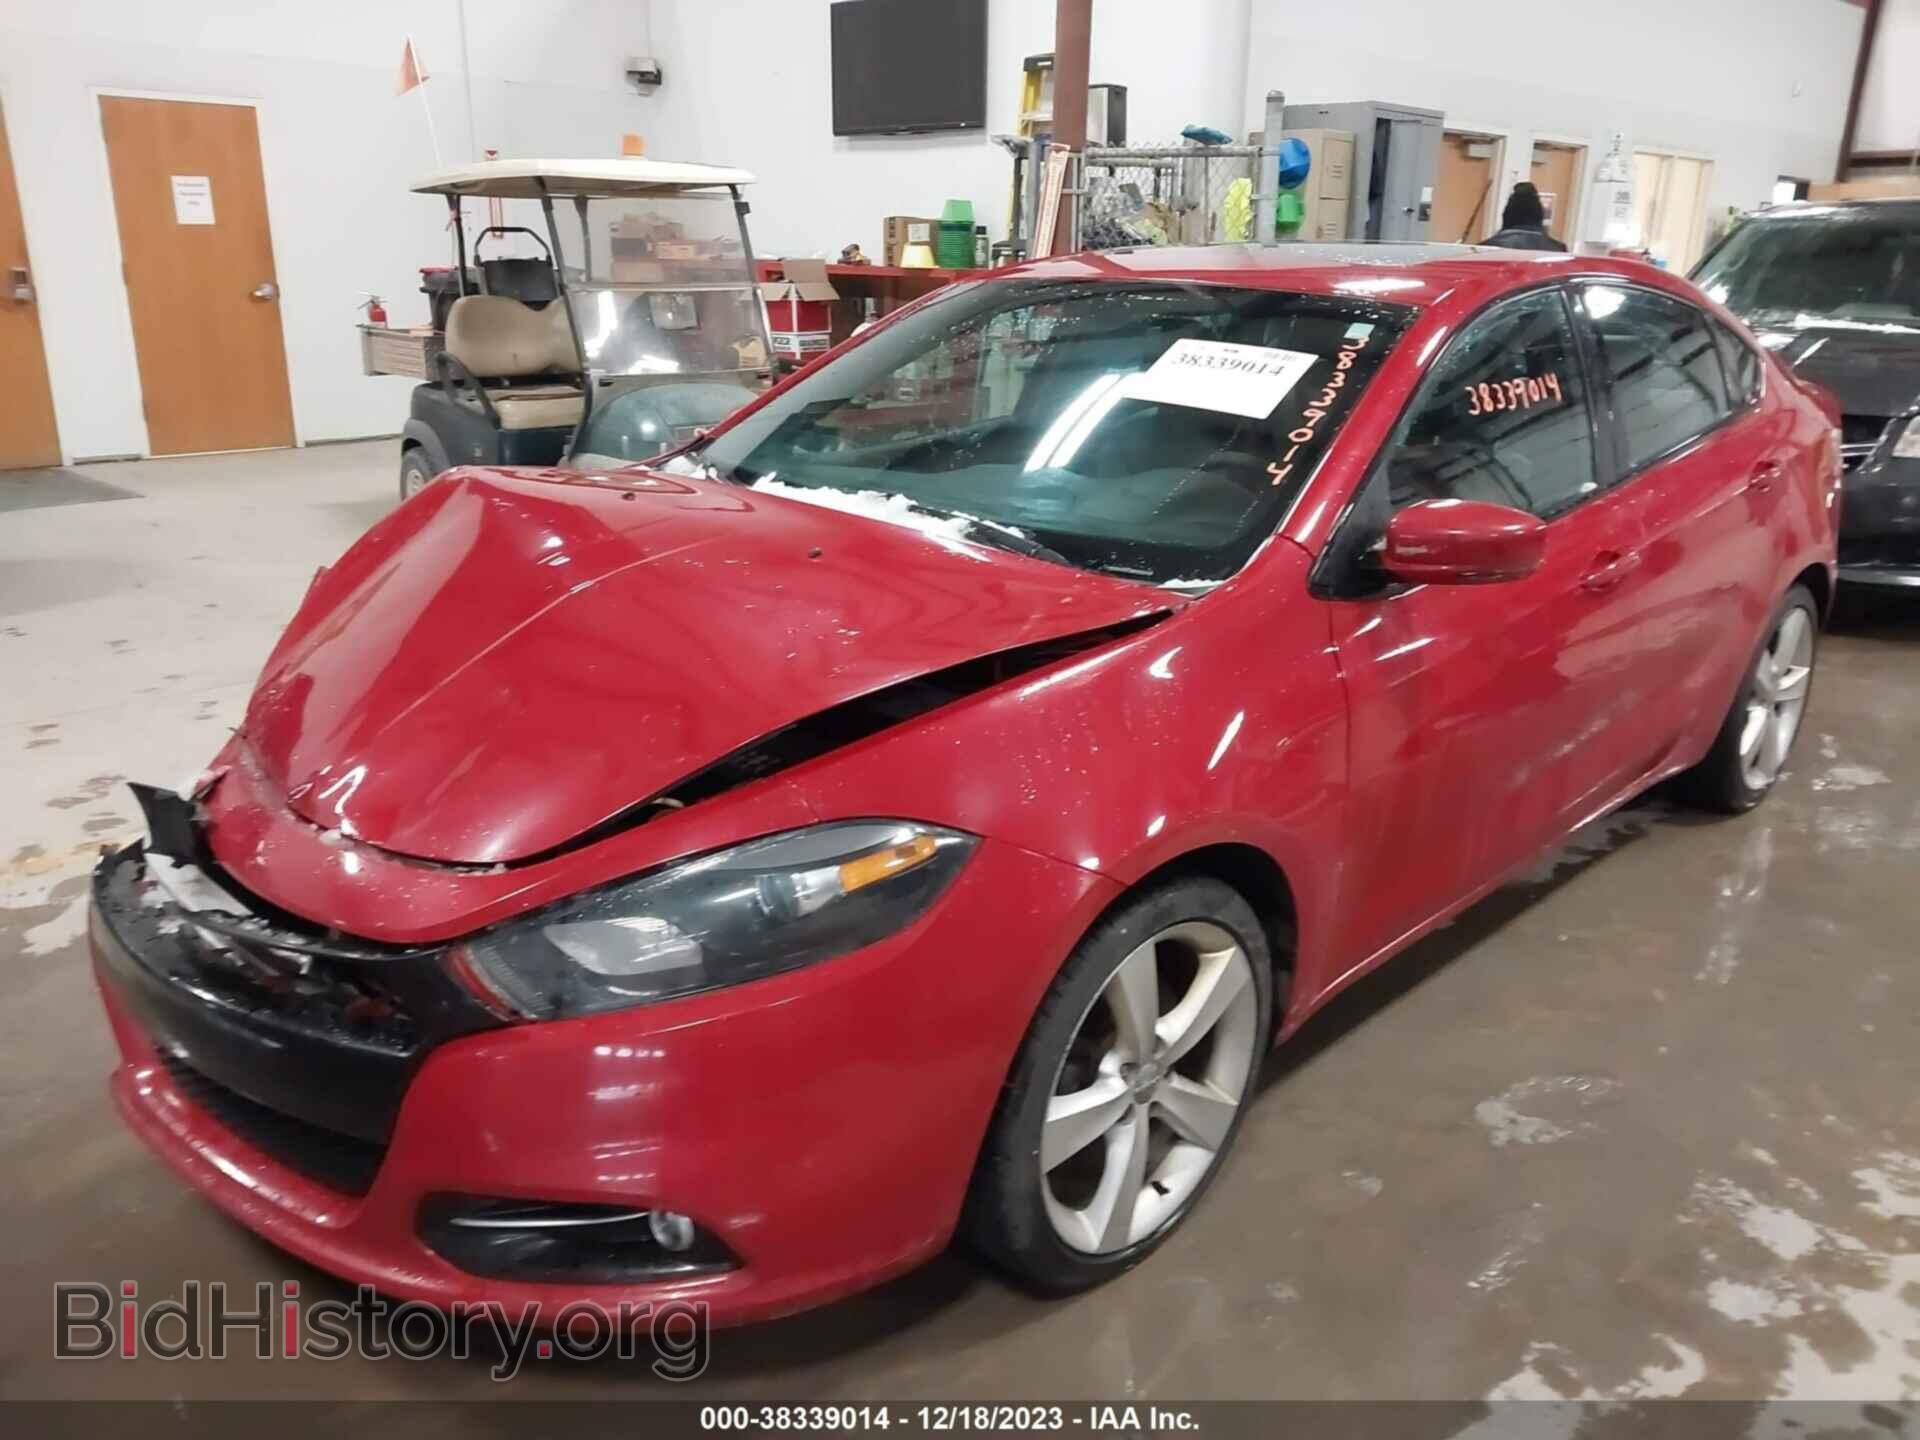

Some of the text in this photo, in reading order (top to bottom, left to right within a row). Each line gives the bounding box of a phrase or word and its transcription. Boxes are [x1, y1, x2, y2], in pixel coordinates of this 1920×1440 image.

[1171, 353, 1286, 377] 38339014
[1266, 336, 1370, 486] 38339014
[1464, 372, 1562, 416] 38339014
